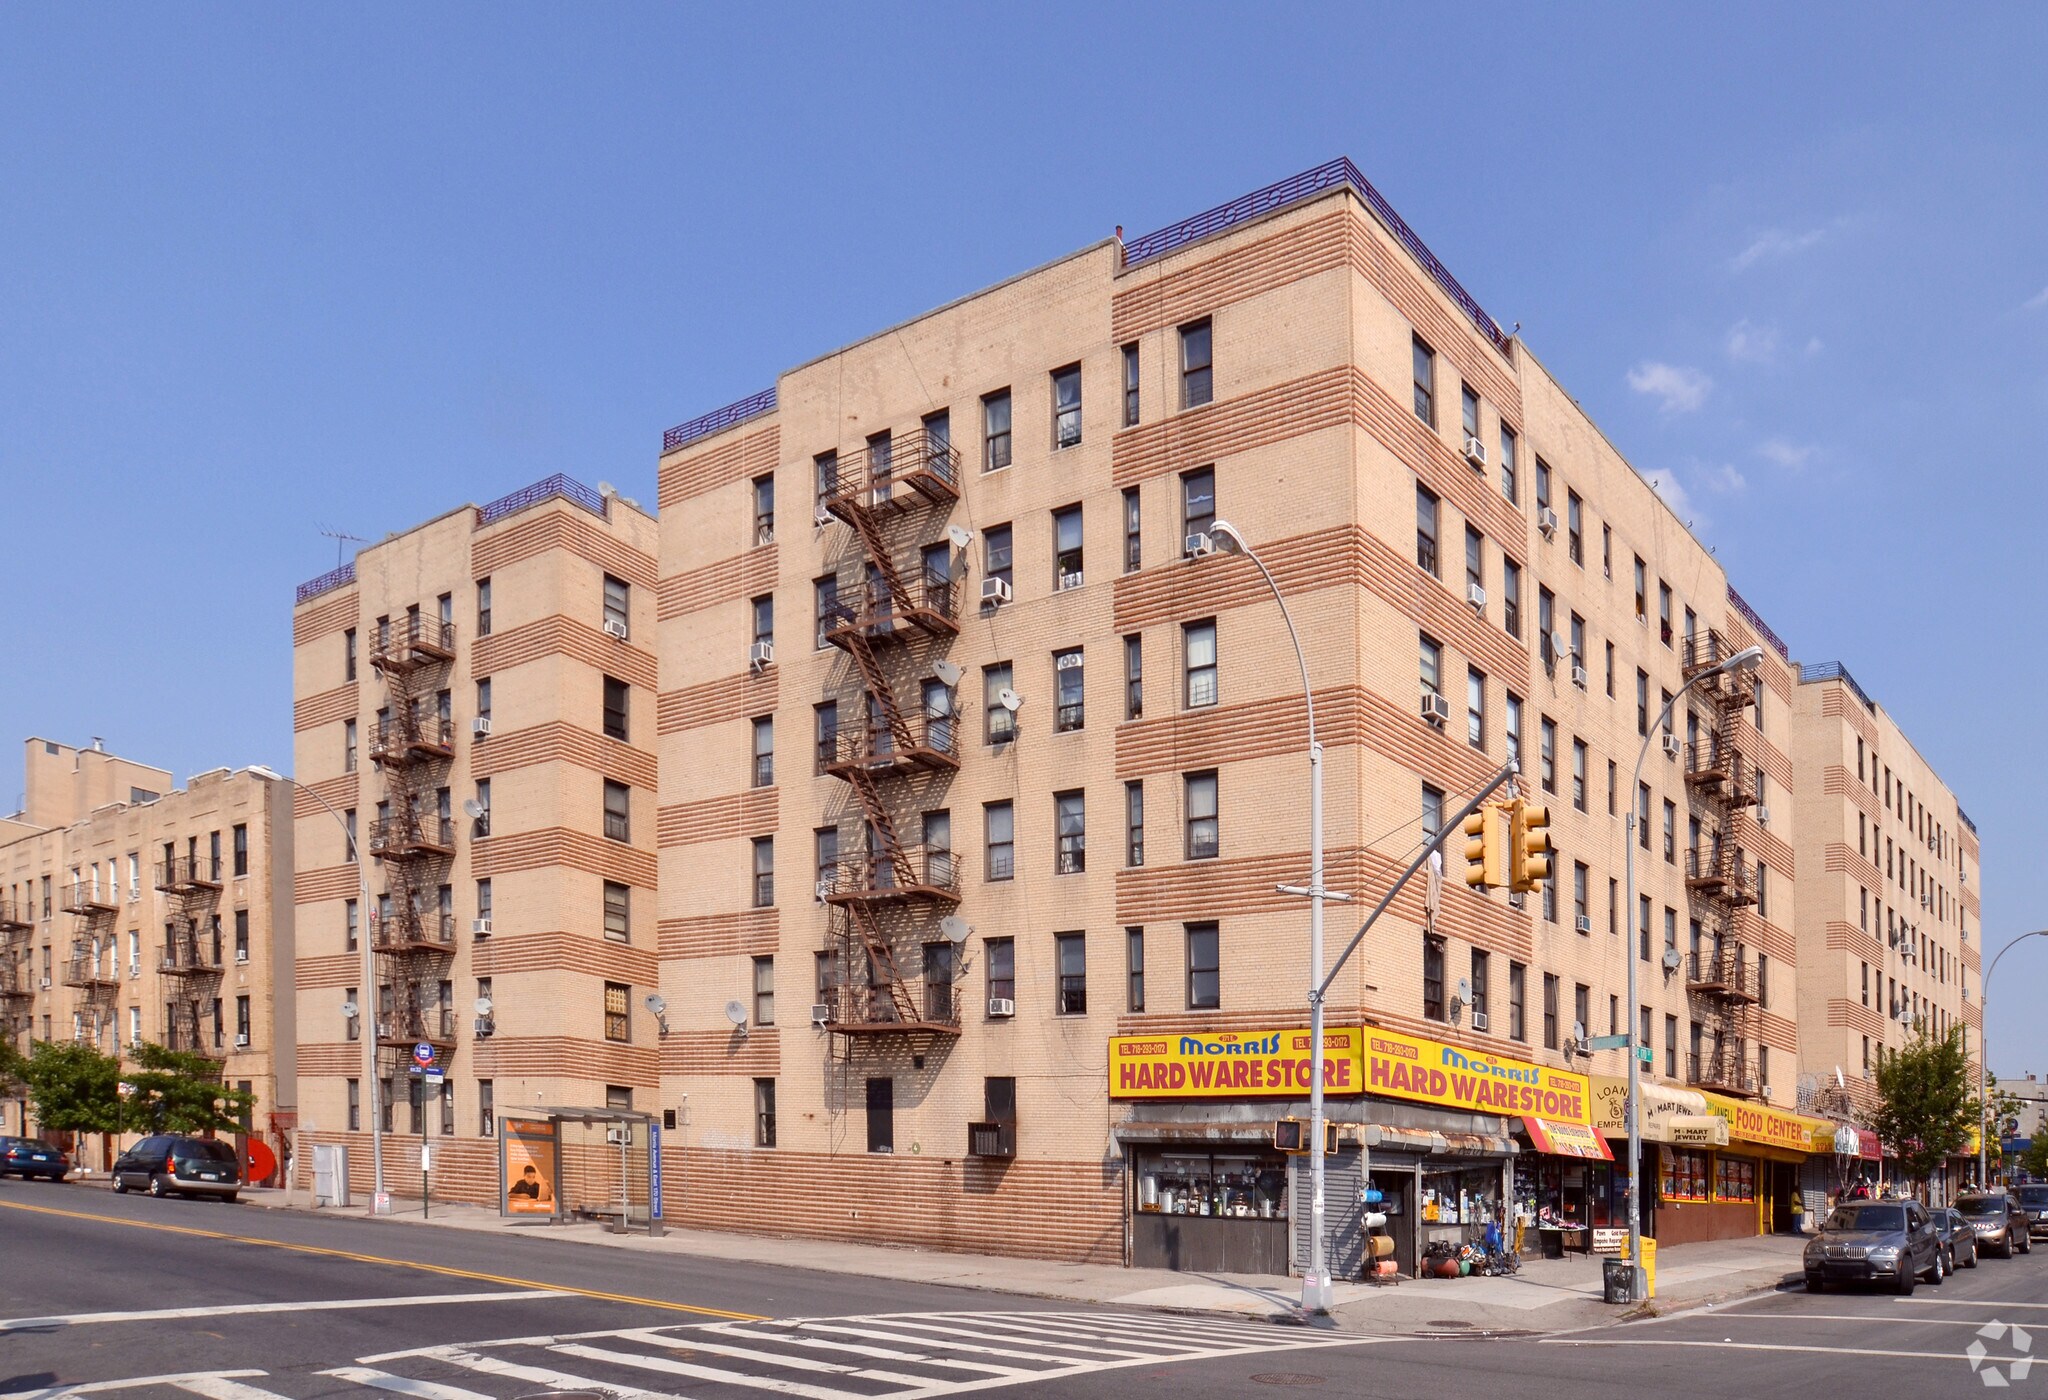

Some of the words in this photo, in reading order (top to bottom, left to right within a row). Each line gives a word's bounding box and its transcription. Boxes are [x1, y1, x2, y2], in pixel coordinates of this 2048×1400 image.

[1597, 1085, 1628, 1100] LOAN
[1657, 1102, 1675, 1114] MART
[1597, 1120, 1622, 1128] EMPE
[1736, 1107, 1763, 1132] FOOD
[1767, 1115, 1802, 1141] CENTER
